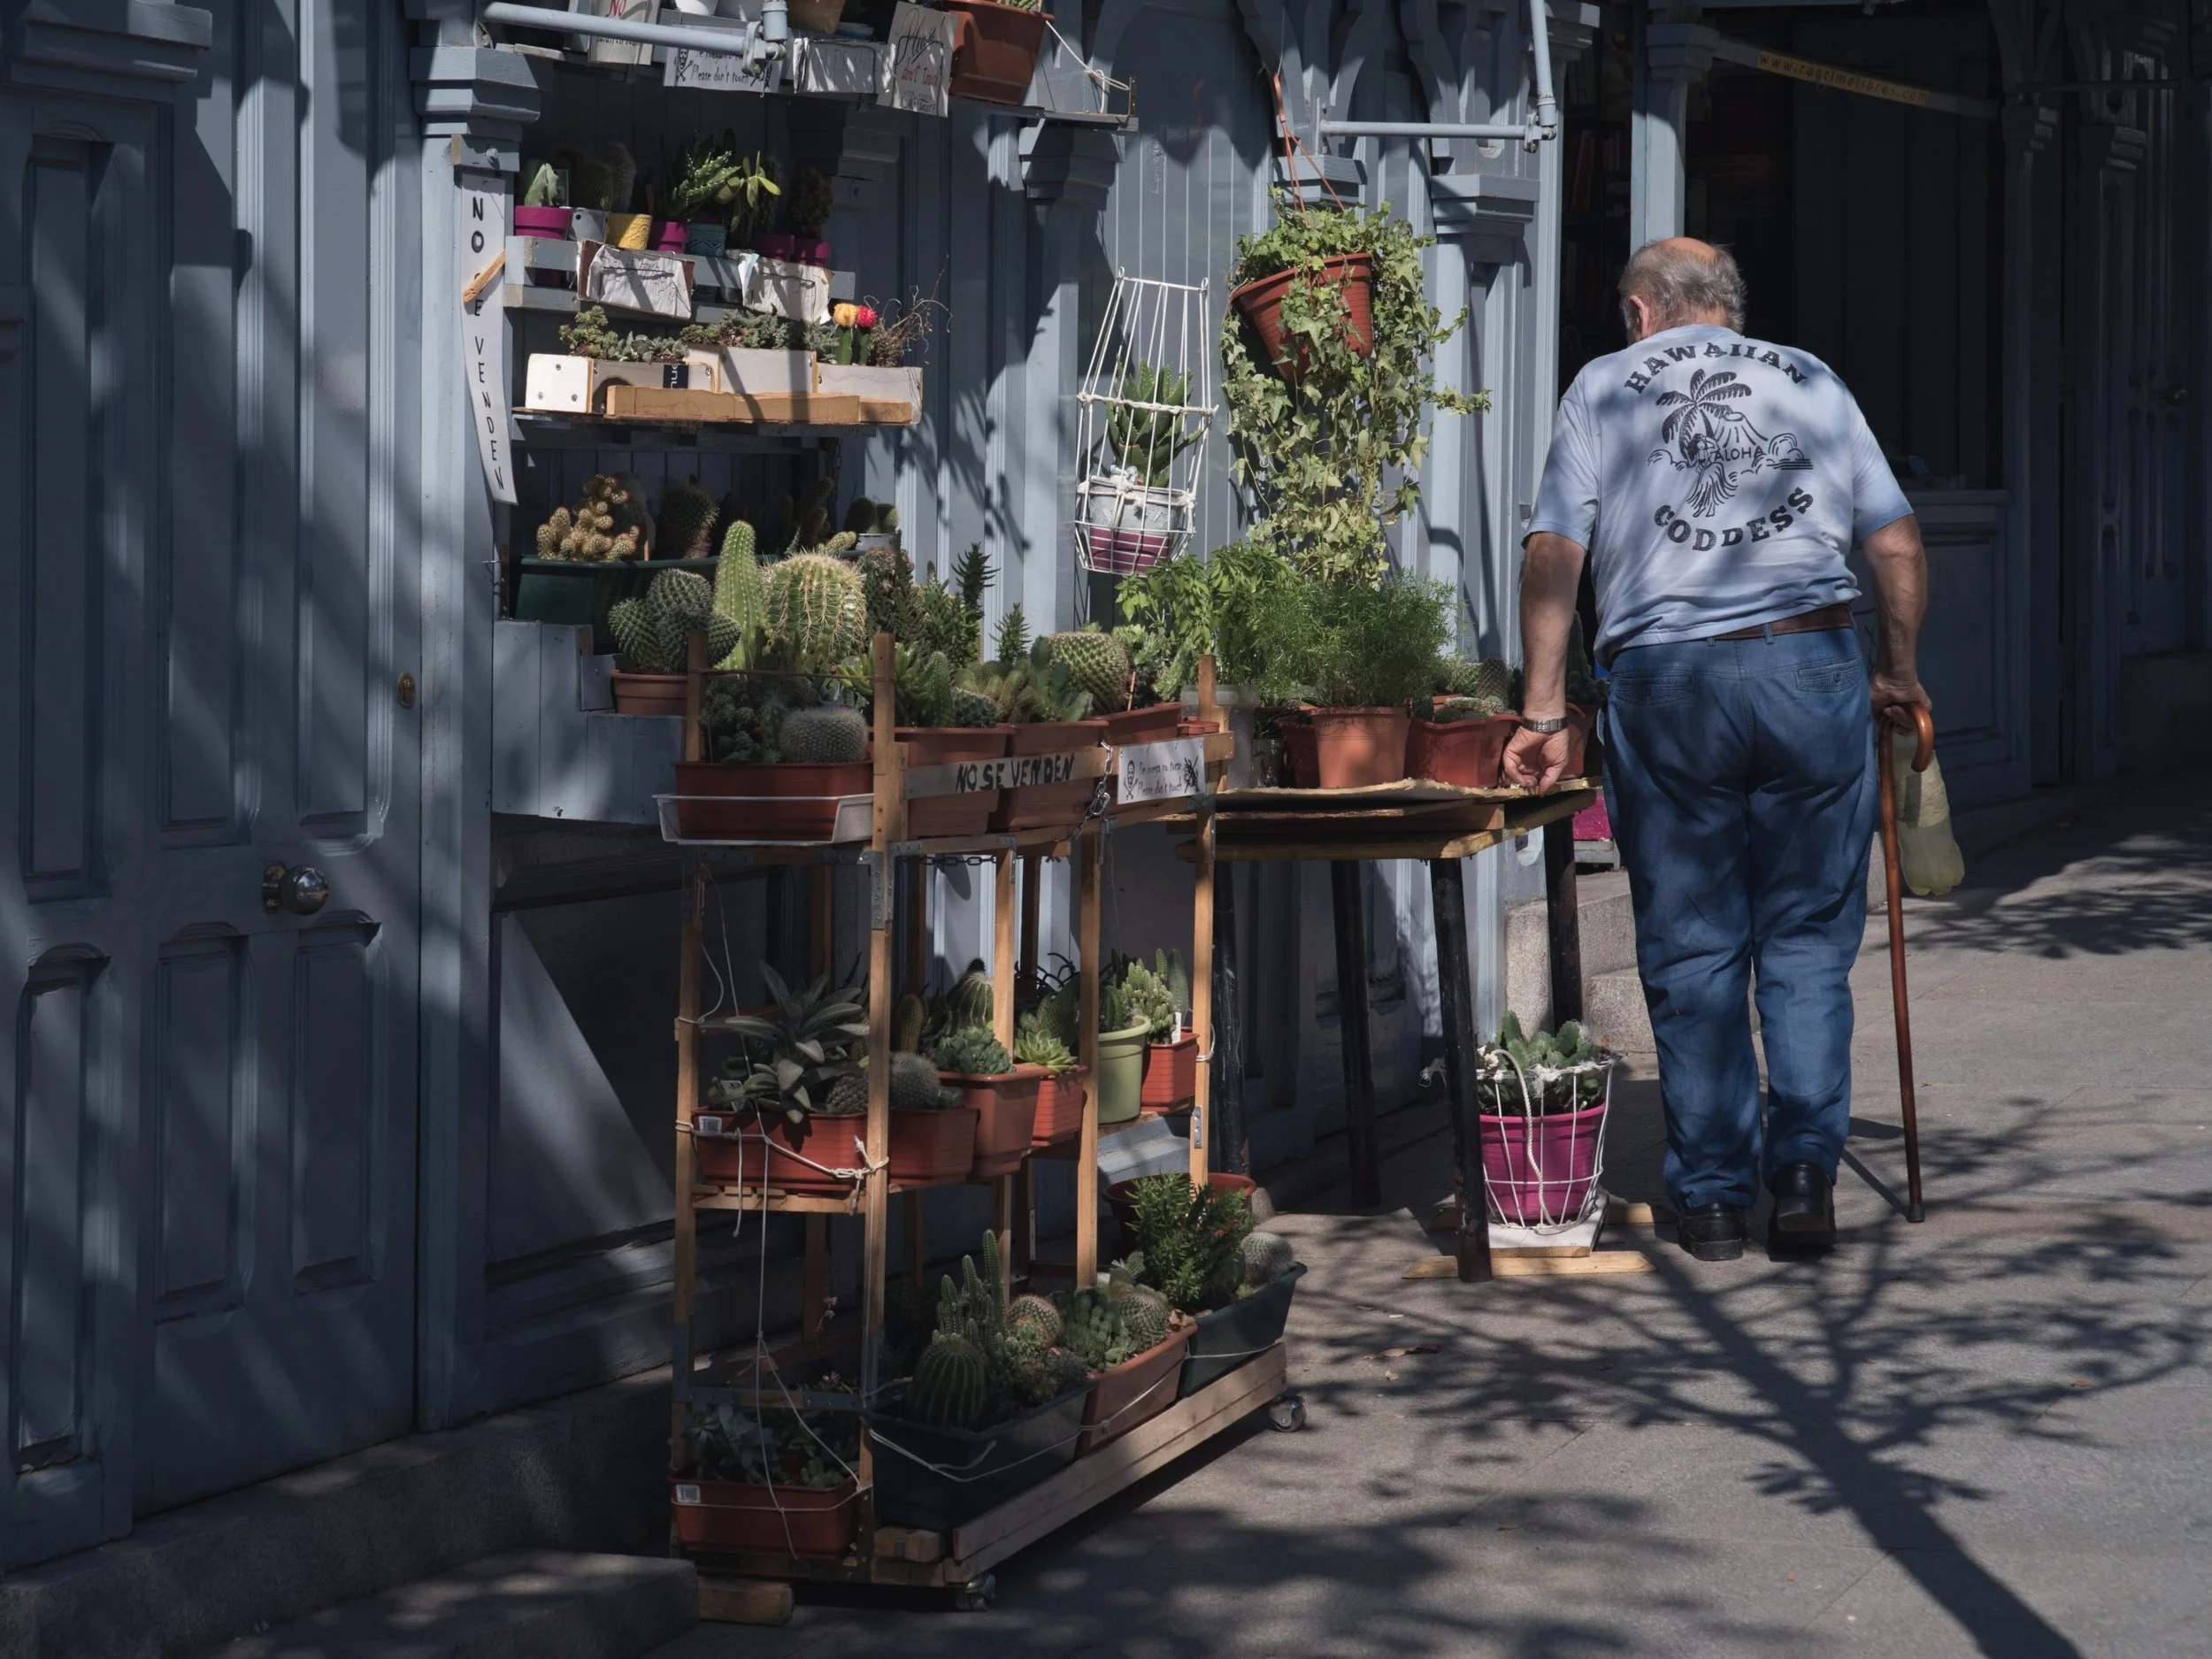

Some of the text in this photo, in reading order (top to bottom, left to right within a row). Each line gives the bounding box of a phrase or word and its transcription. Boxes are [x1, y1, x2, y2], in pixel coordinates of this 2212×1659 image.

[691, 64, 711, 81] Please
[714, 65, 729, 83] don't
[471, 196, 484, 253] NO
[1624, 342, 1808, 395] HAWAIIAN
[475, 335, 504, 490] VENDEN
[1715, 445, 1767, 462] ALOHA
[1654, 487, 1814, 552] GODDESS
[956, 751, 1075, 794] NO SE VENDEN
